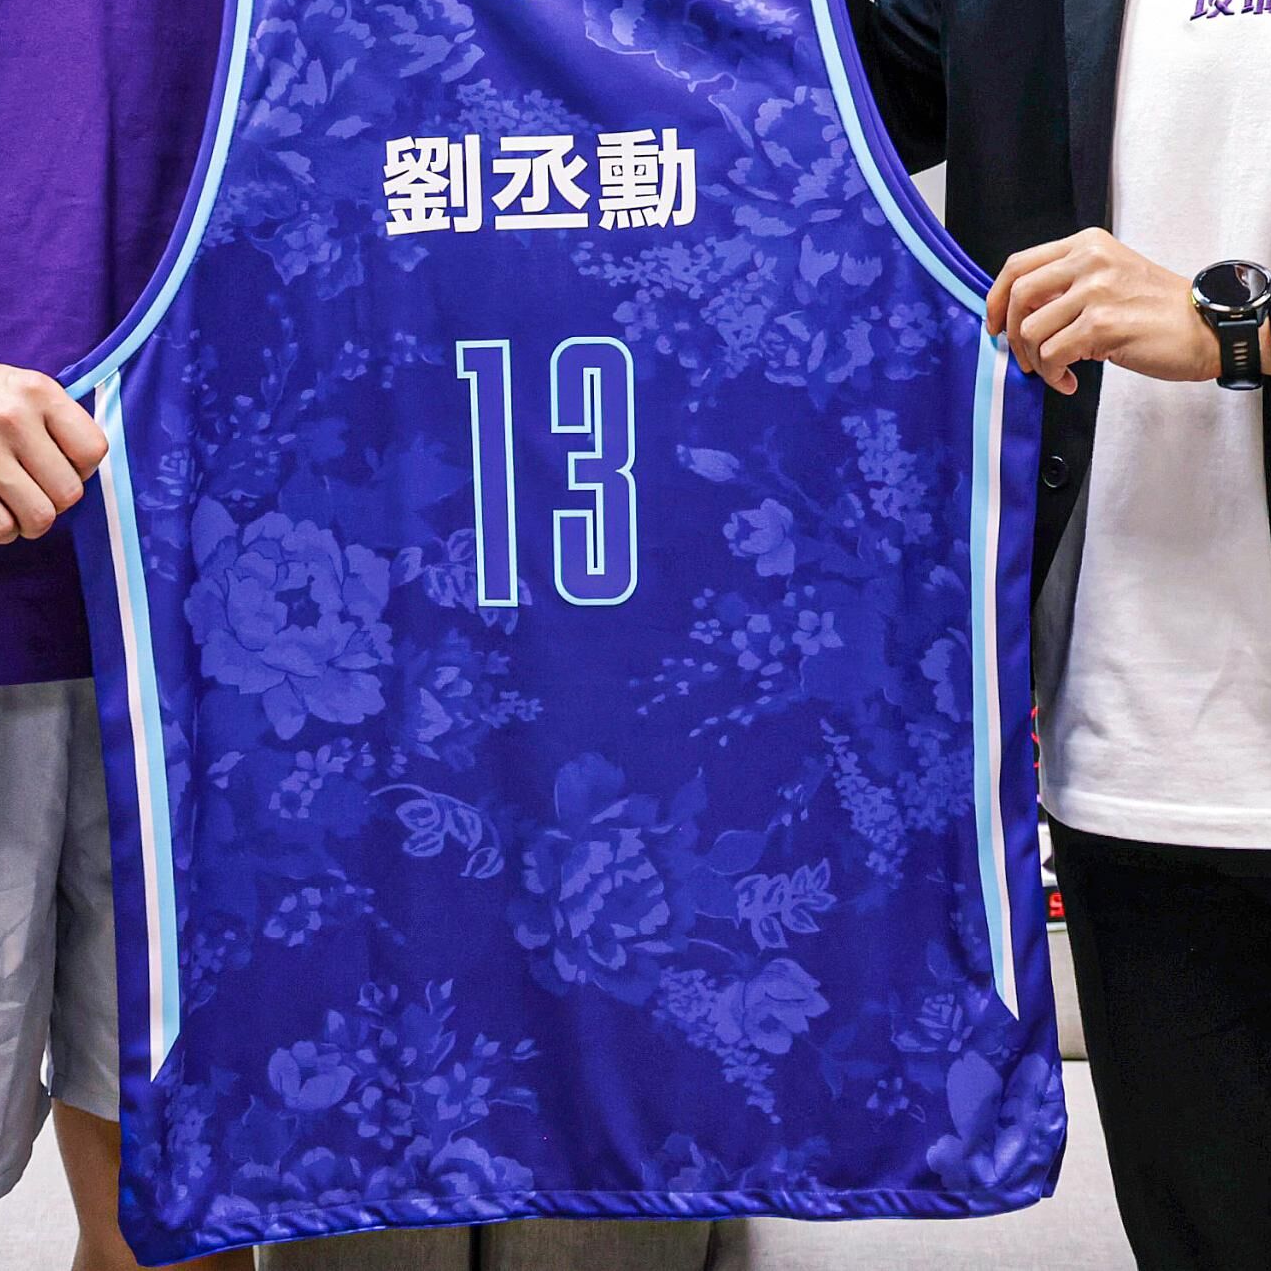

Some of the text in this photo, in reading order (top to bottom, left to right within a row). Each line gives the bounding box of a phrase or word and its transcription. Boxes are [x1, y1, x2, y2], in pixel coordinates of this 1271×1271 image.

[382, 128, 697, 236] 劉丞勳
[455, 336, 638, 607] 13
